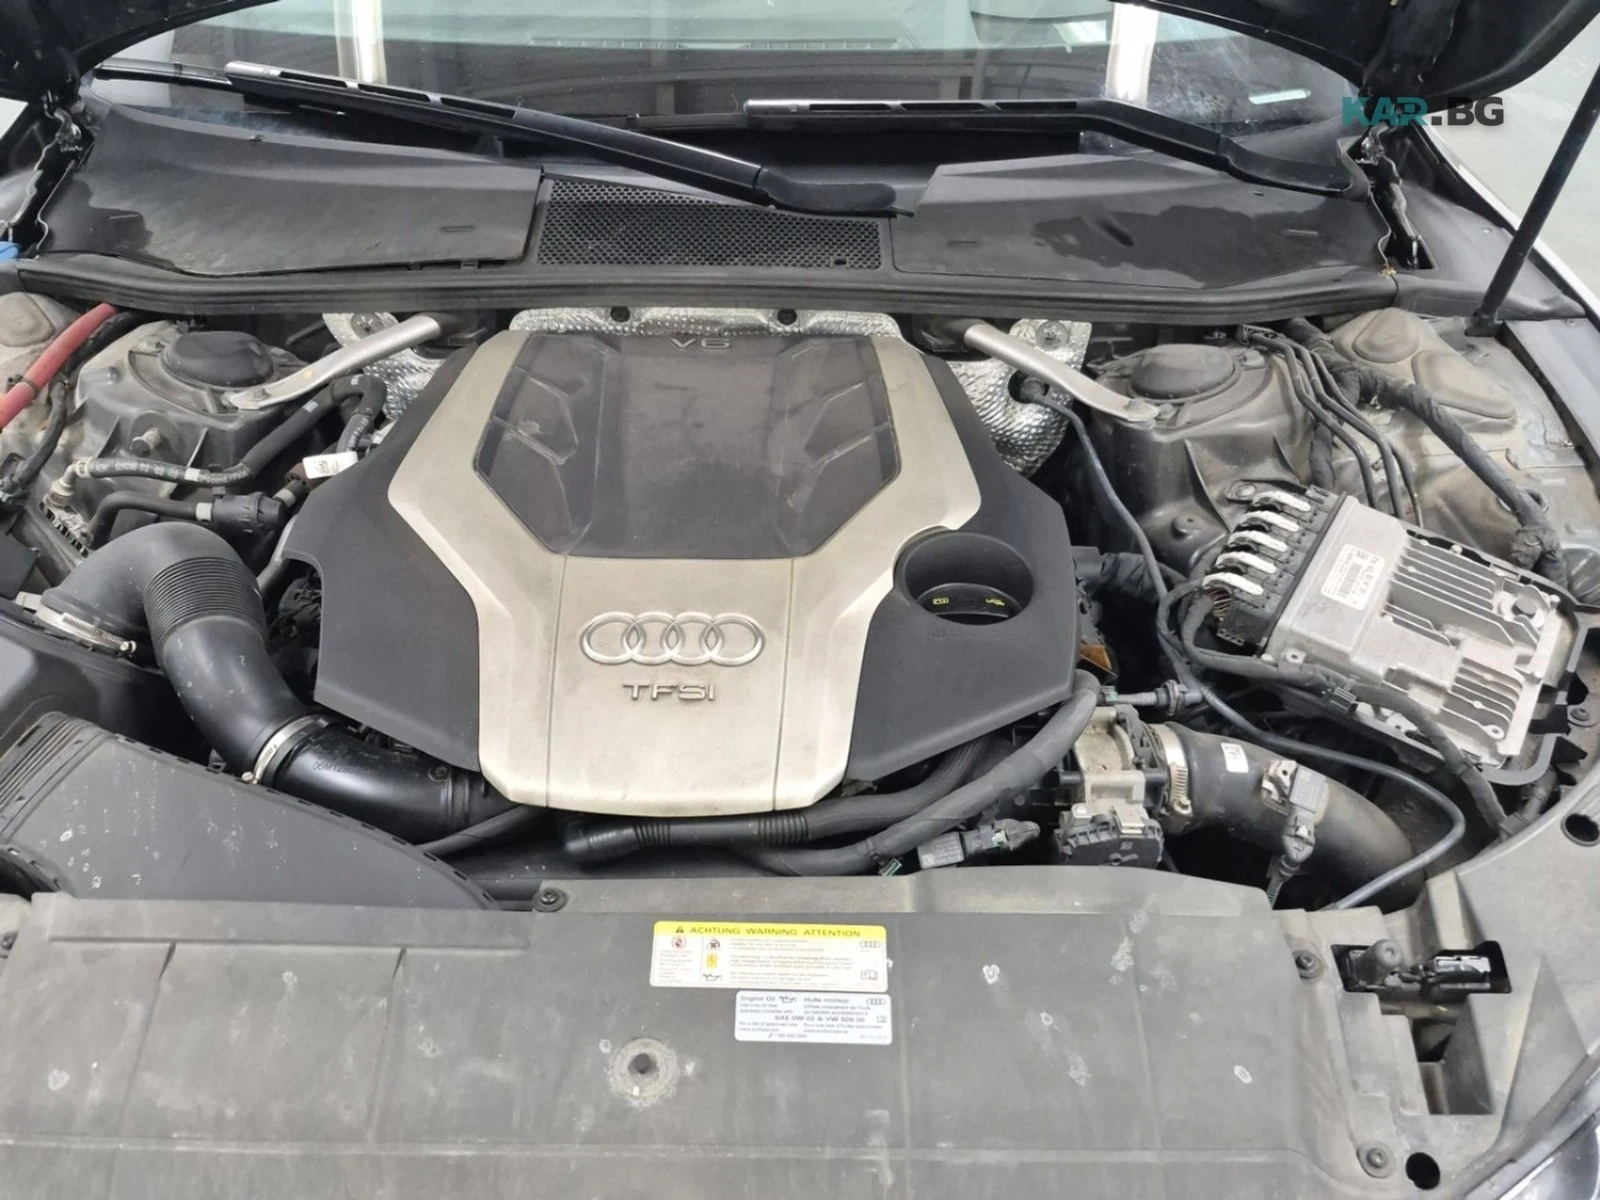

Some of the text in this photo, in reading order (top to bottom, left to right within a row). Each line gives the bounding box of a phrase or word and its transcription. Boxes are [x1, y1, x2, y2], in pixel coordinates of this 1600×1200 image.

[669, 338, 731, 350] V6
[622, 683, 716, 701] TFSI
[689, 926, 861, 937] ACHTUNG WARNING ATTENTION
[740, 995, 764, 1003] Engine
